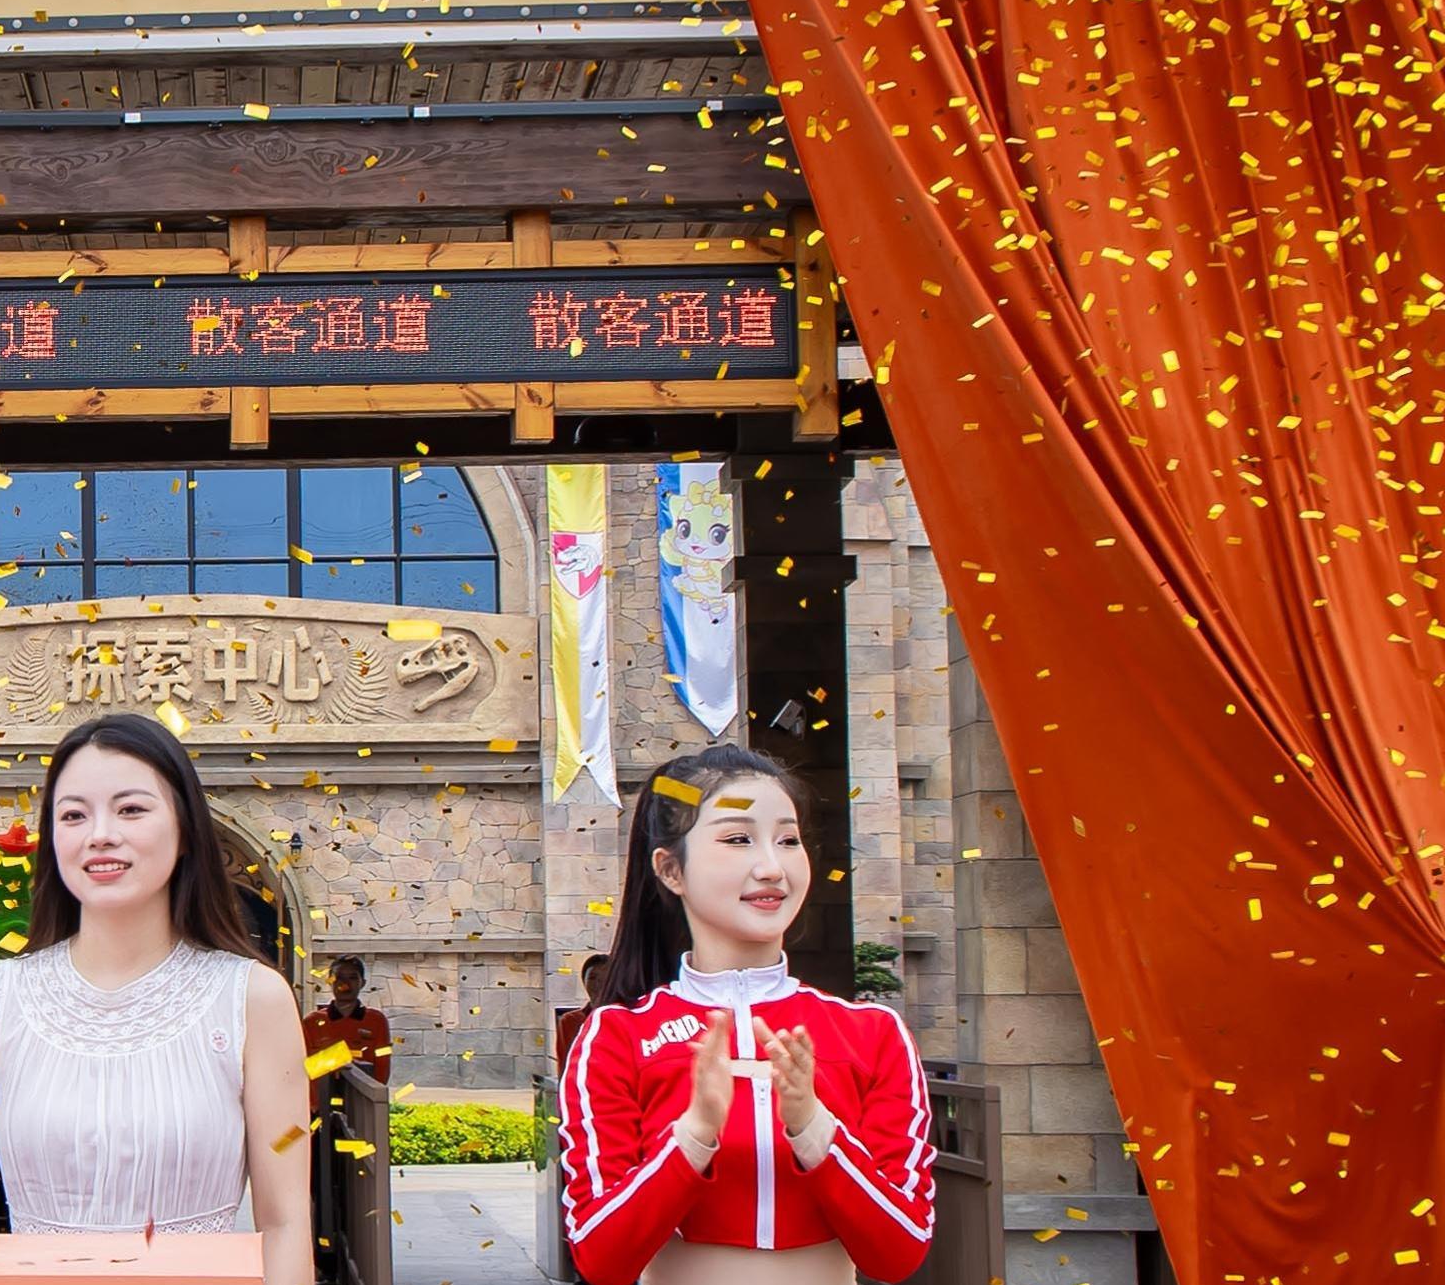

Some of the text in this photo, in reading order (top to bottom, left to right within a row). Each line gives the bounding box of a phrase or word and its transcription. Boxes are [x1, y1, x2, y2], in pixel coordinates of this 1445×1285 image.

[186, 293, 433, 355] 散客通道
[528, 288, 778, 350] 散客通道
[60, 626, 334, 705] 探索中心
